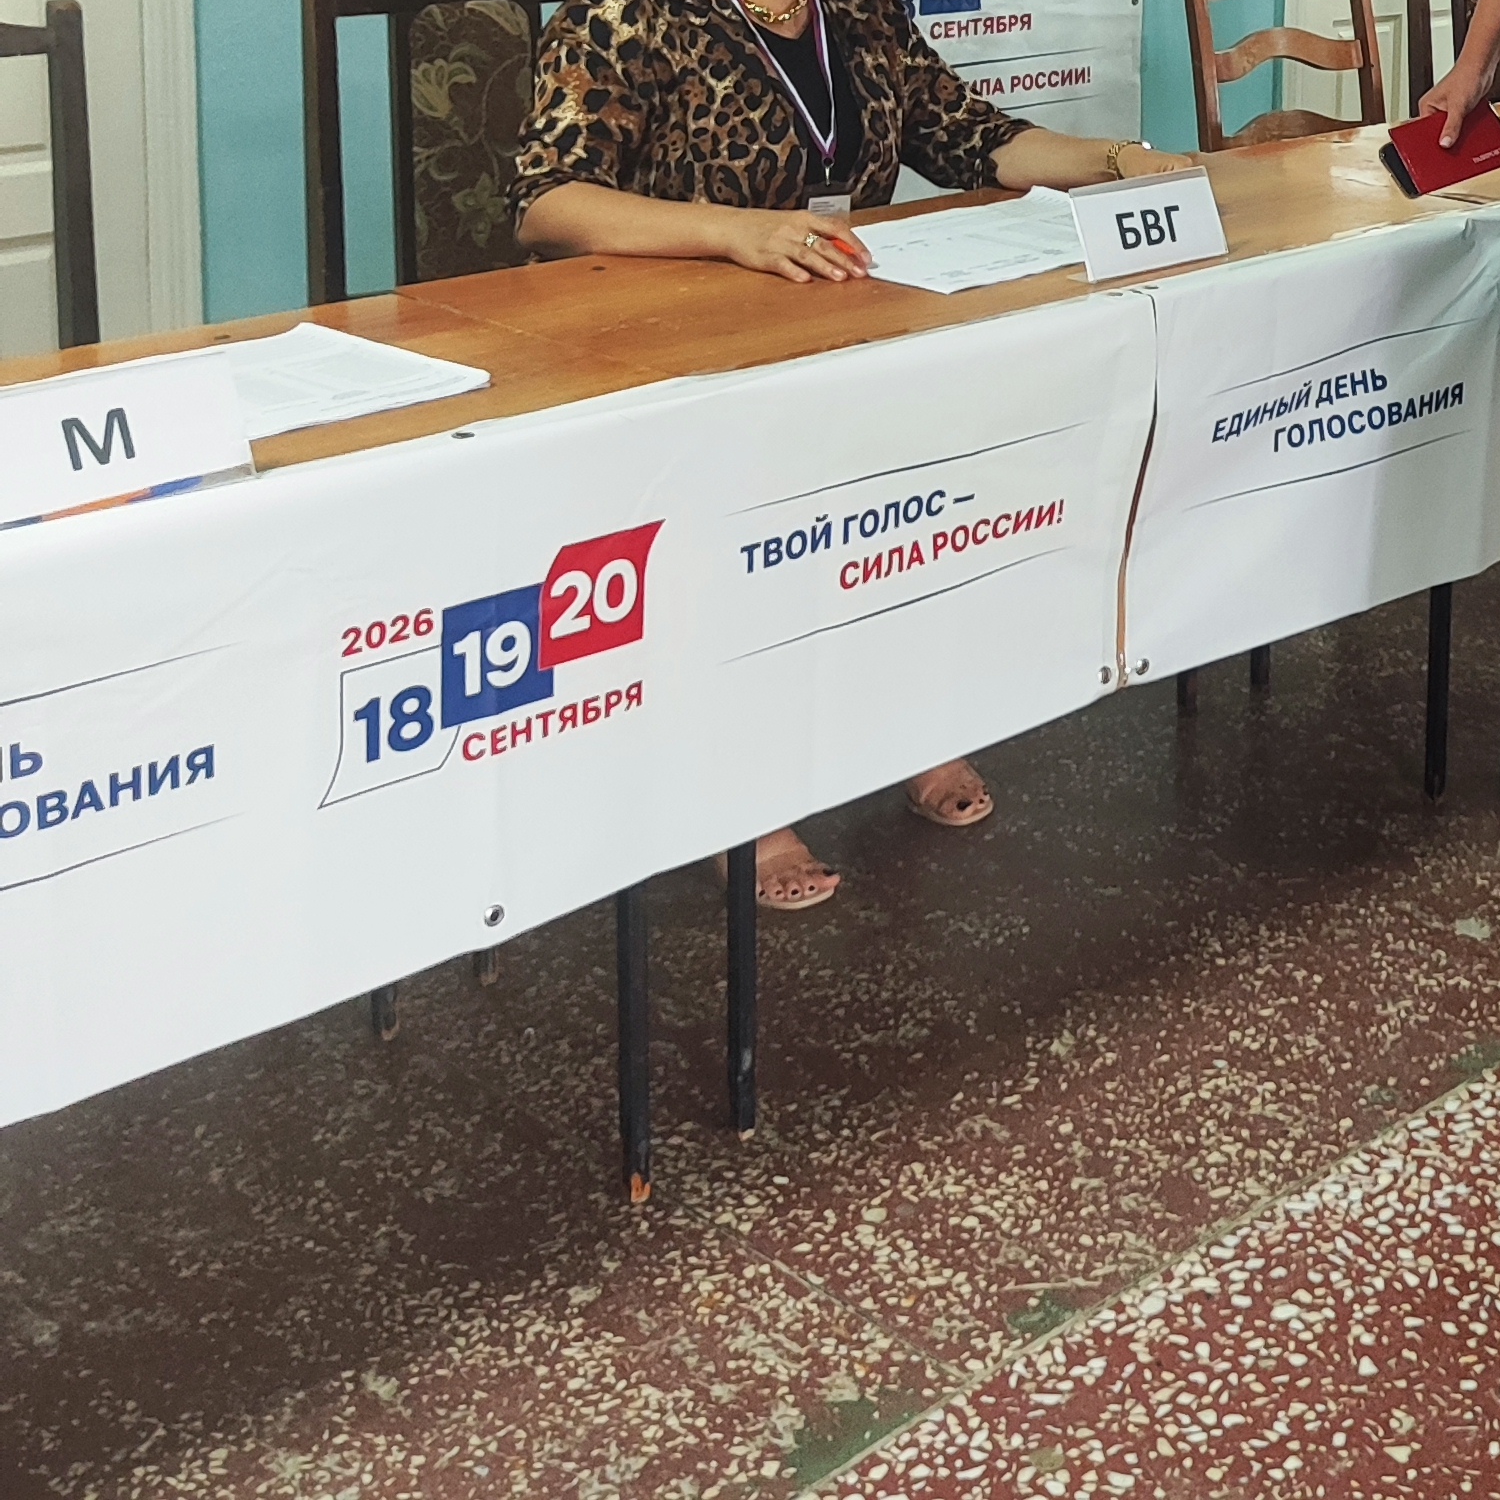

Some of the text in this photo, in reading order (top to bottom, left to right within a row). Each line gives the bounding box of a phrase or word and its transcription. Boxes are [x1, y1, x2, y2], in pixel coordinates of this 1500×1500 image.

[930, 13, 1032, 40] СЕНТЯБРЯ
[1010, 66, 1092, 93] РОССИИ!
[1115, 205, 1180, 250] БВГ
[61, 408, 136, 471] М
[1212, 368, 1388, 443] ЕДИНЫЙ ДЕНЬ
[1273, 382, 1464, 452] ГОЛОСОВАНИЯ
[740, 514, 832, 573] ТВОЙ
[843, 489, 947, 545] ГОЛОС
[839, 499, 1065, 590] СИЛА РОССИИ!
[342, 608, 434, 657] 2026
[550, 558, 638, 640] 20
[452, 620, 532, 698] 19
[354, 685, 434, 763] 18
[461, 680, 643, 761] СЕНТЯБРЯ
